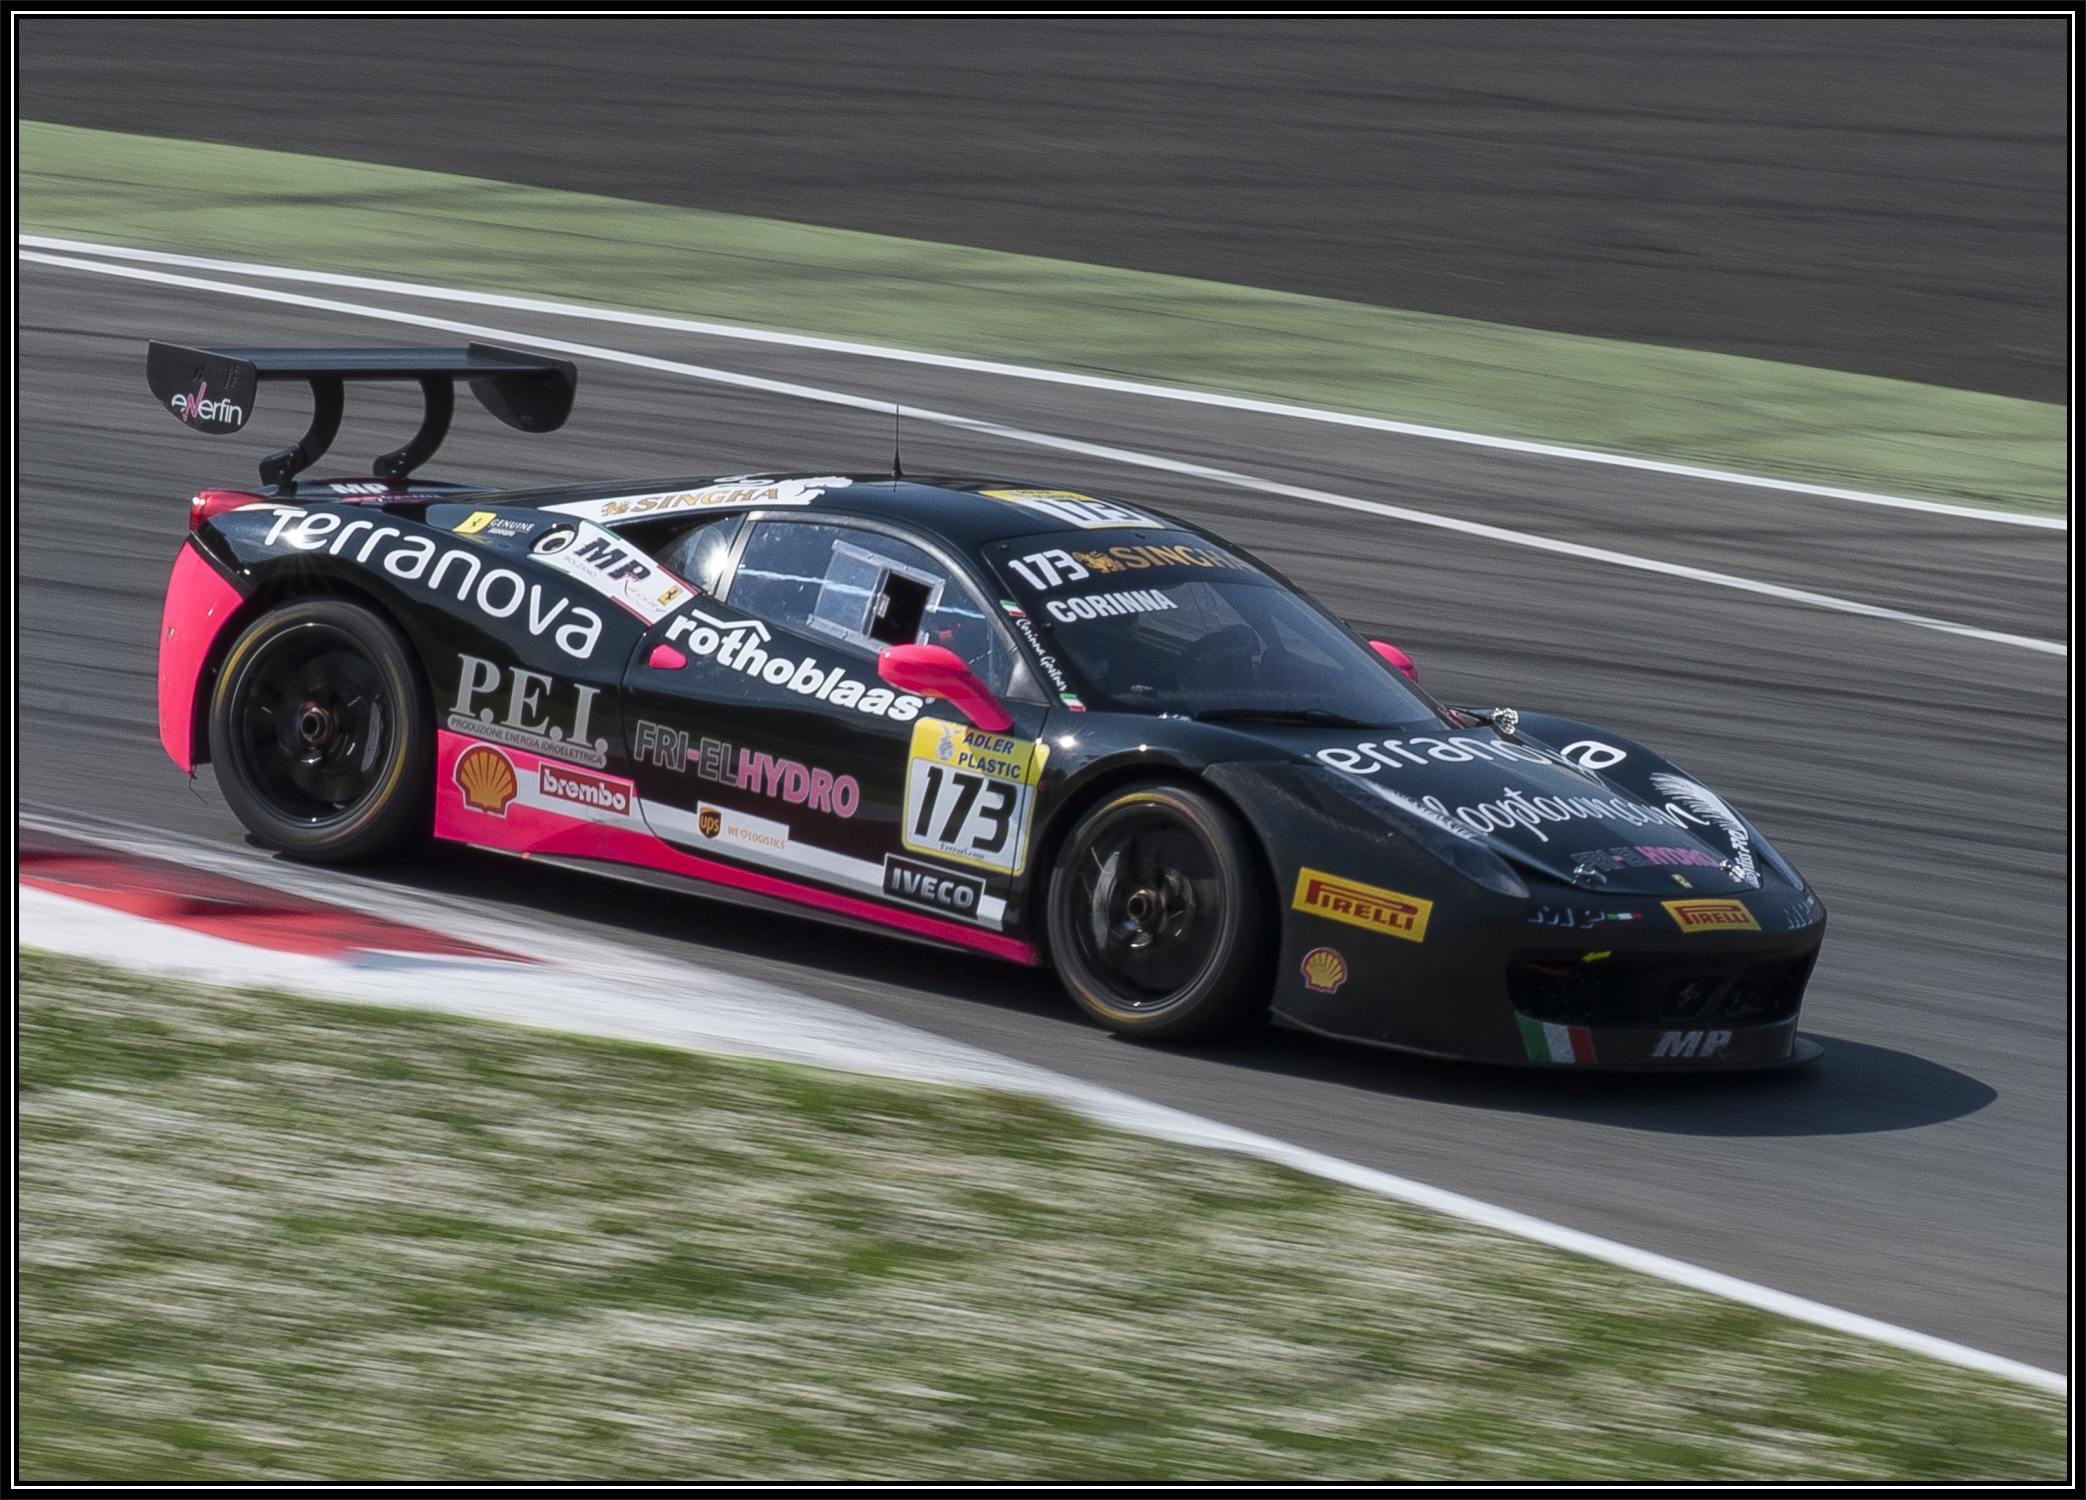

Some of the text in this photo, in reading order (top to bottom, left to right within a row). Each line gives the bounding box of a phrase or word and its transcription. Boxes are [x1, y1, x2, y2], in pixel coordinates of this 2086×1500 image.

[630, 488, 779, 513] SINGHA
[490, 519, 535, 532] GENUINE
[573, 537, 651, 580] MP
[1008, 544, 1258, 590] 173 SINGHA
[263, 508, 603, 659] Terranova
[1046, 589, 1178, 623] CORINNA
[449, 653, 609, 752] P.E.I.
[451, 718, 603, 766] PRODUZIONE ENERGIA IDROELETTRICA
[963, 732, 1014, 755] ADLER
[634, 719, 860, 818] FRI-ELHYDRO
[958, 752, 1021, 779] PLASTIC
[543, 768, 626, 811] brembo
[914, 766, 1018, 854] 173
[700, 815, 720, 835] ups
[727, 825, 785, 850] WE LOGISTICS
[892, 867, 974, 908] IVECO
[1305, 879, 1418, 931] PIRELLI
[1674, 905, 1750, 926] PIRELLI
[1651, 1030, 1733, 1058] MP
